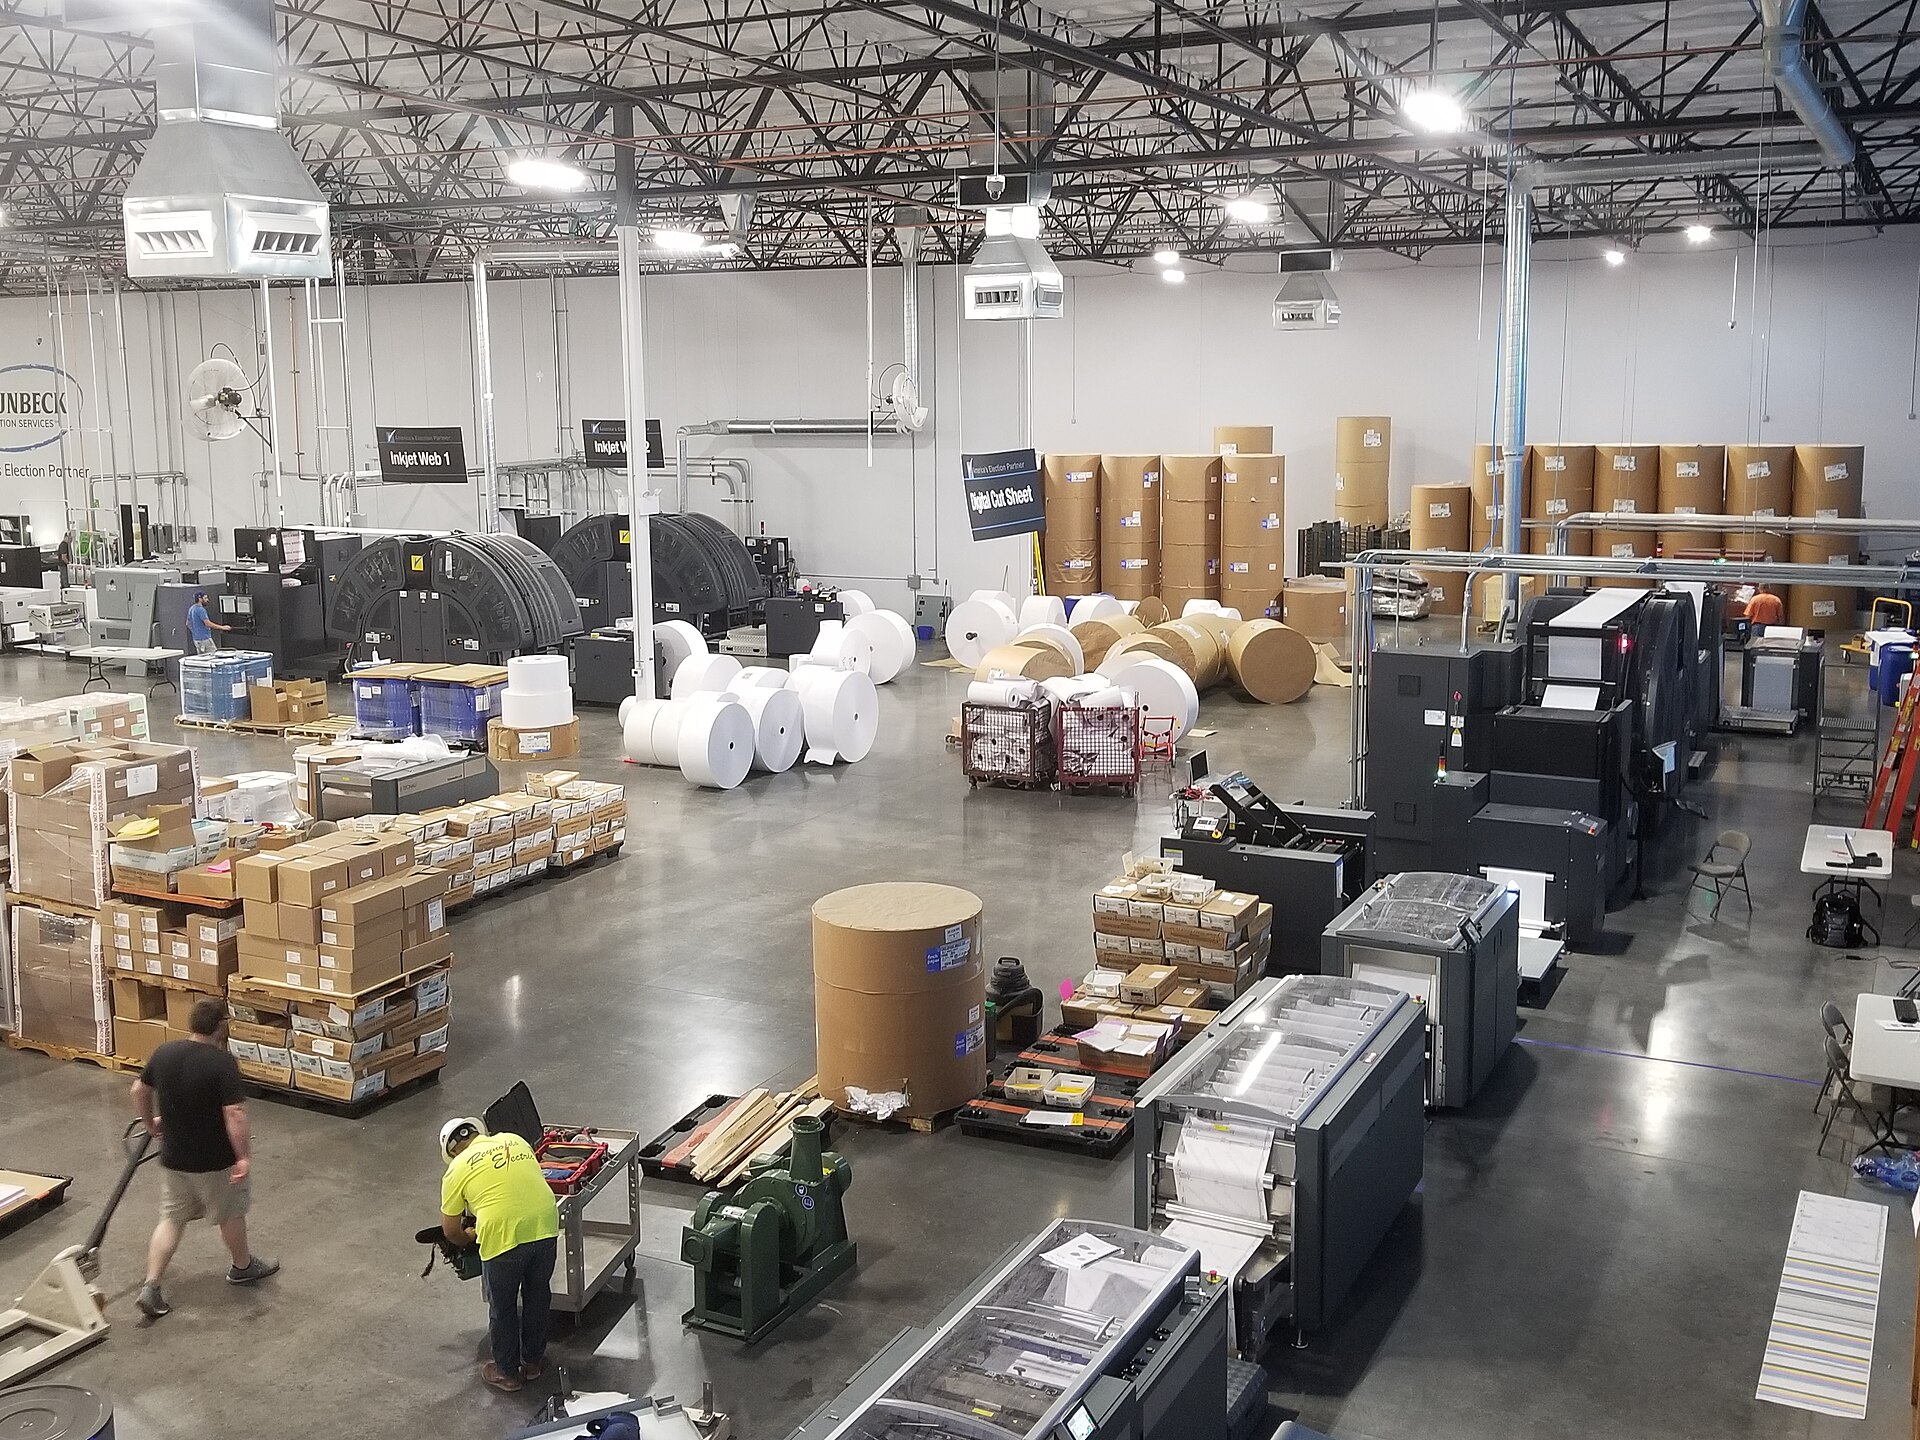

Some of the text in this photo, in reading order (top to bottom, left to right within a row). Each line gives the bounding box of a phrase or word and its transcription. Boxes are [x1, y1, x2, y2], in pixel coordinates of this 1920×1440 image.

[18, 420, 54, 428] SERVICES
[594, 440, 620, 456] Inkjet
[390, 450, 452, 468] Inkjet Web 1
[4, 463, 45, 477] Election
[970, 484, 1034, 514] Digital Cut Sheet
[99, 823, 104, 831] DO
